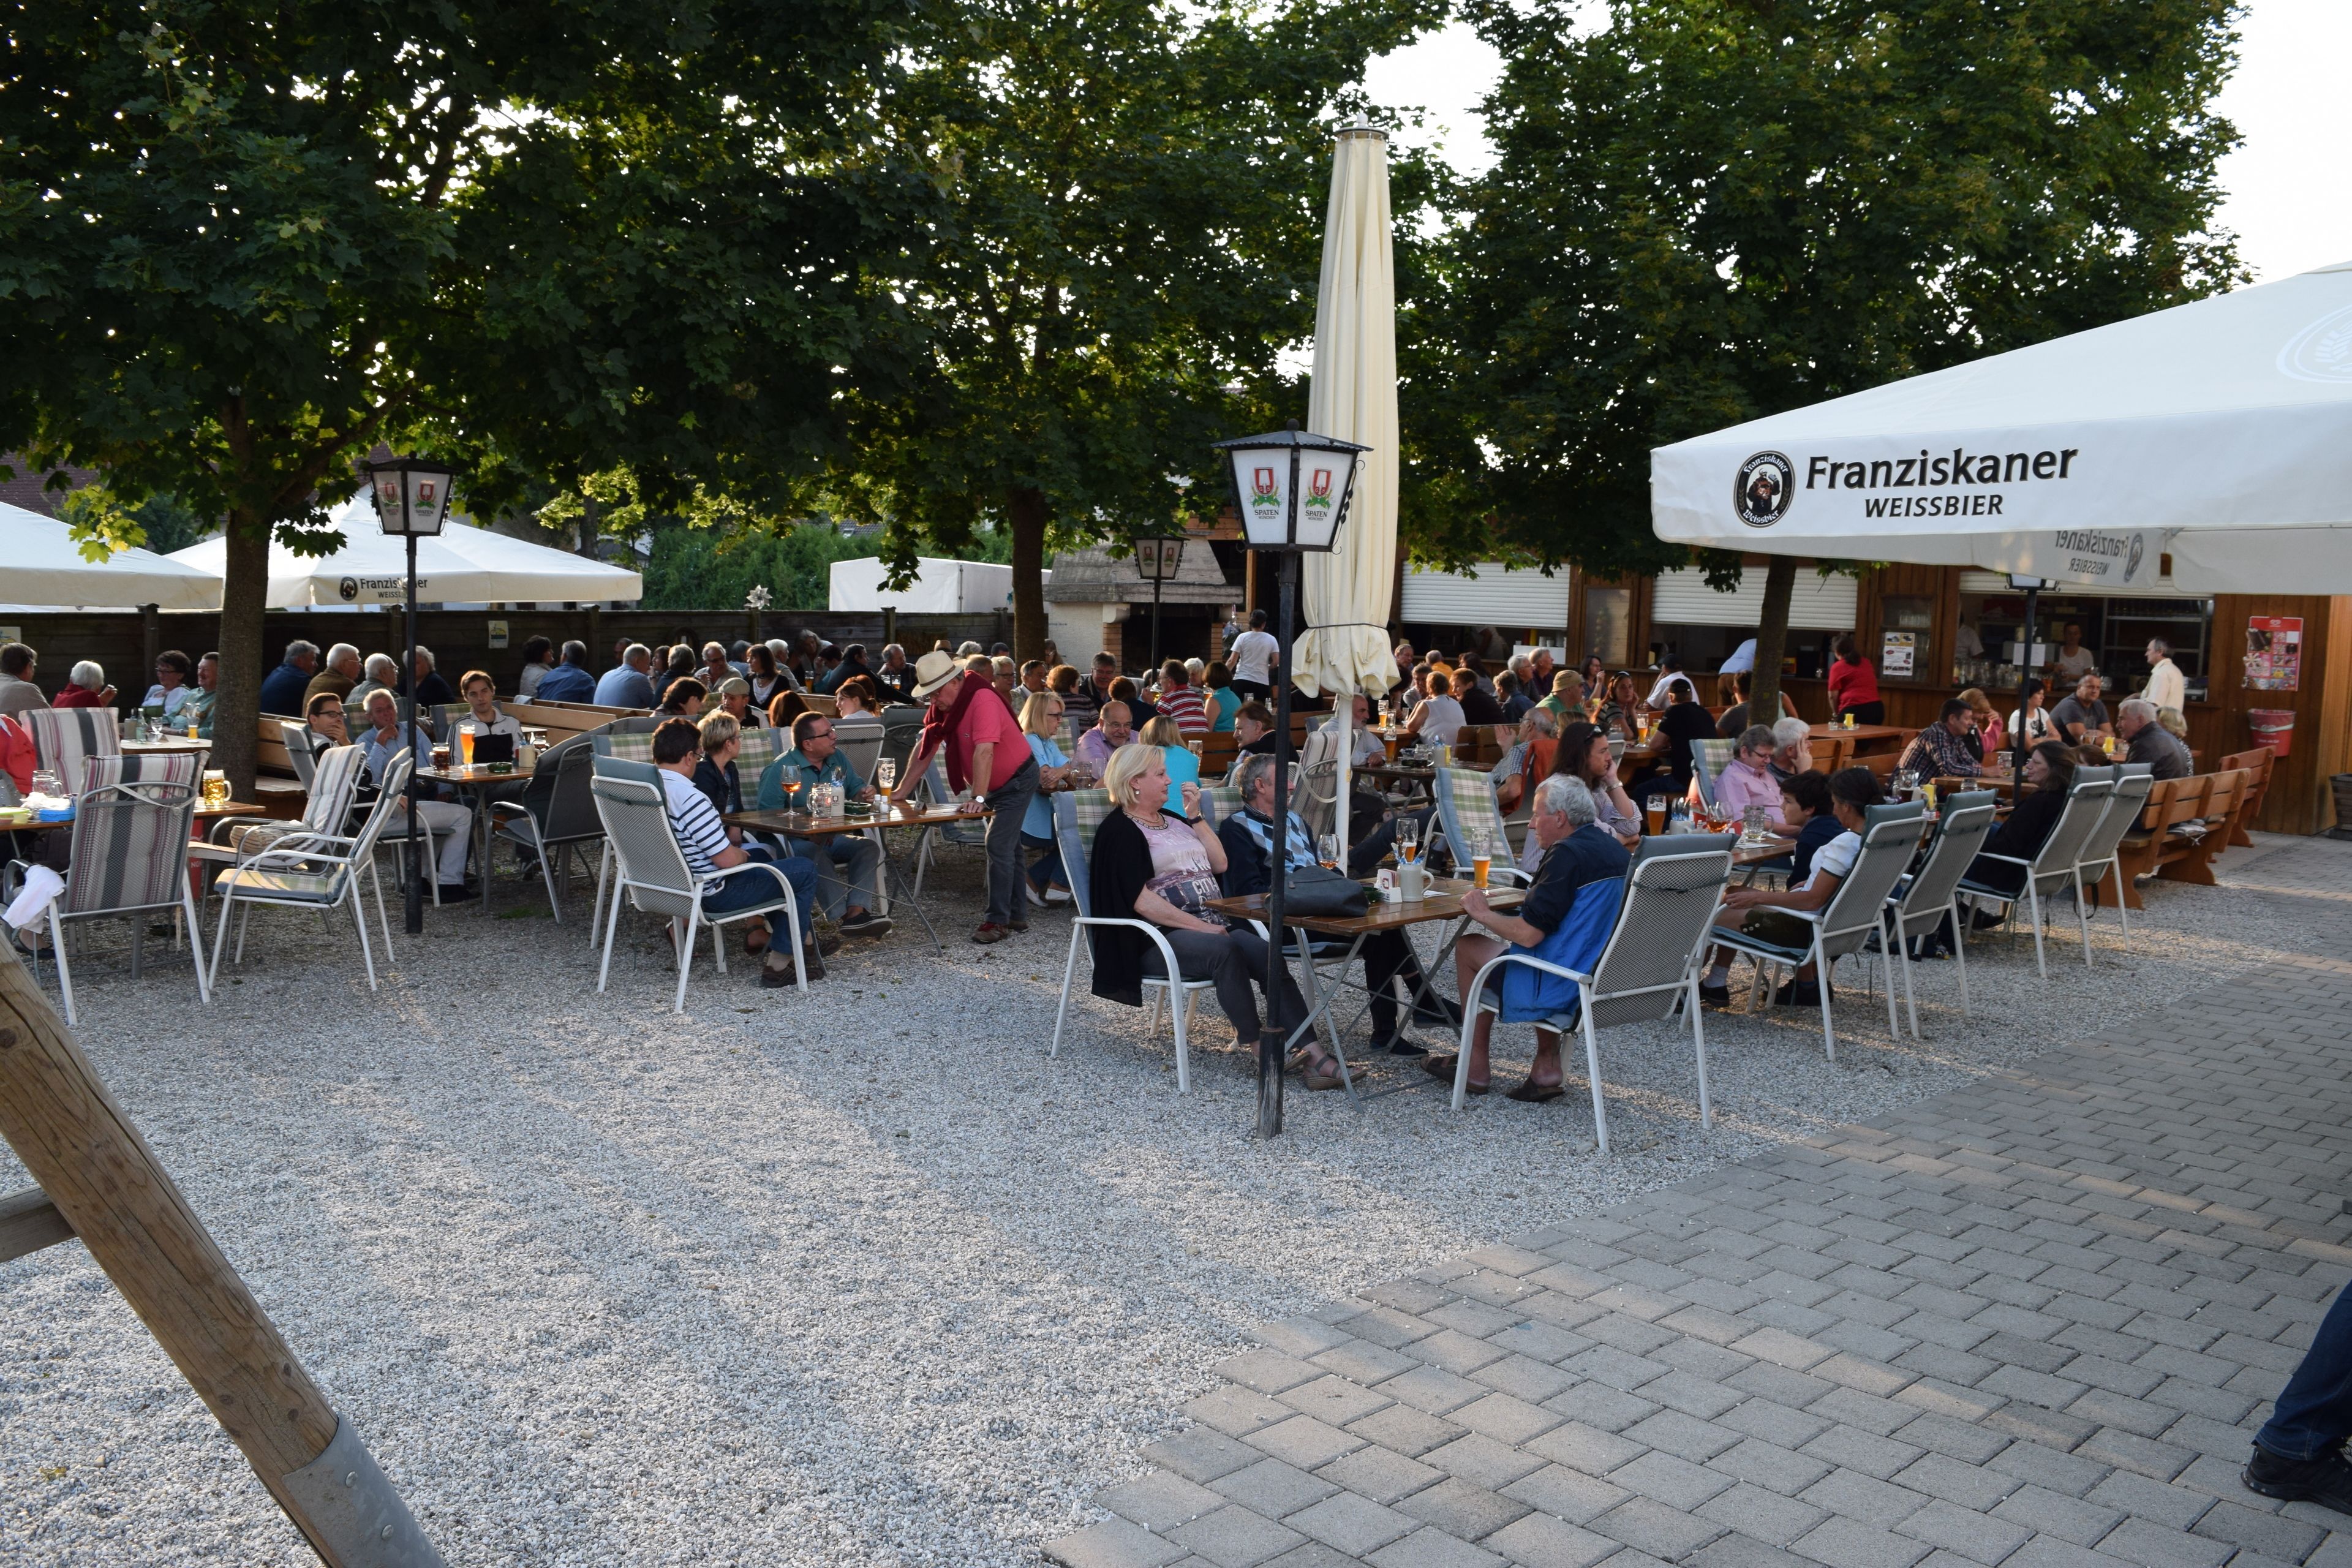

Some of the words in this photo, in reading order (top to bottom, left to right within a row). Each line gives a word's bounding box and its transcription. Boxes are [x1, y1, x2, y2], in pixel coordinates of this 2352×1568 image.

[1743, 454, 1789, 474] Franziskaner
[1806, 448, 2079, 489] Franziskaner
[1865, 494, 2003, 518] WEISSBIER
[1743, 509, 1779, 523] Weissbier
[360, 578, 428, 589] Franziser
[1192, 877, 1215, 895] CITY
